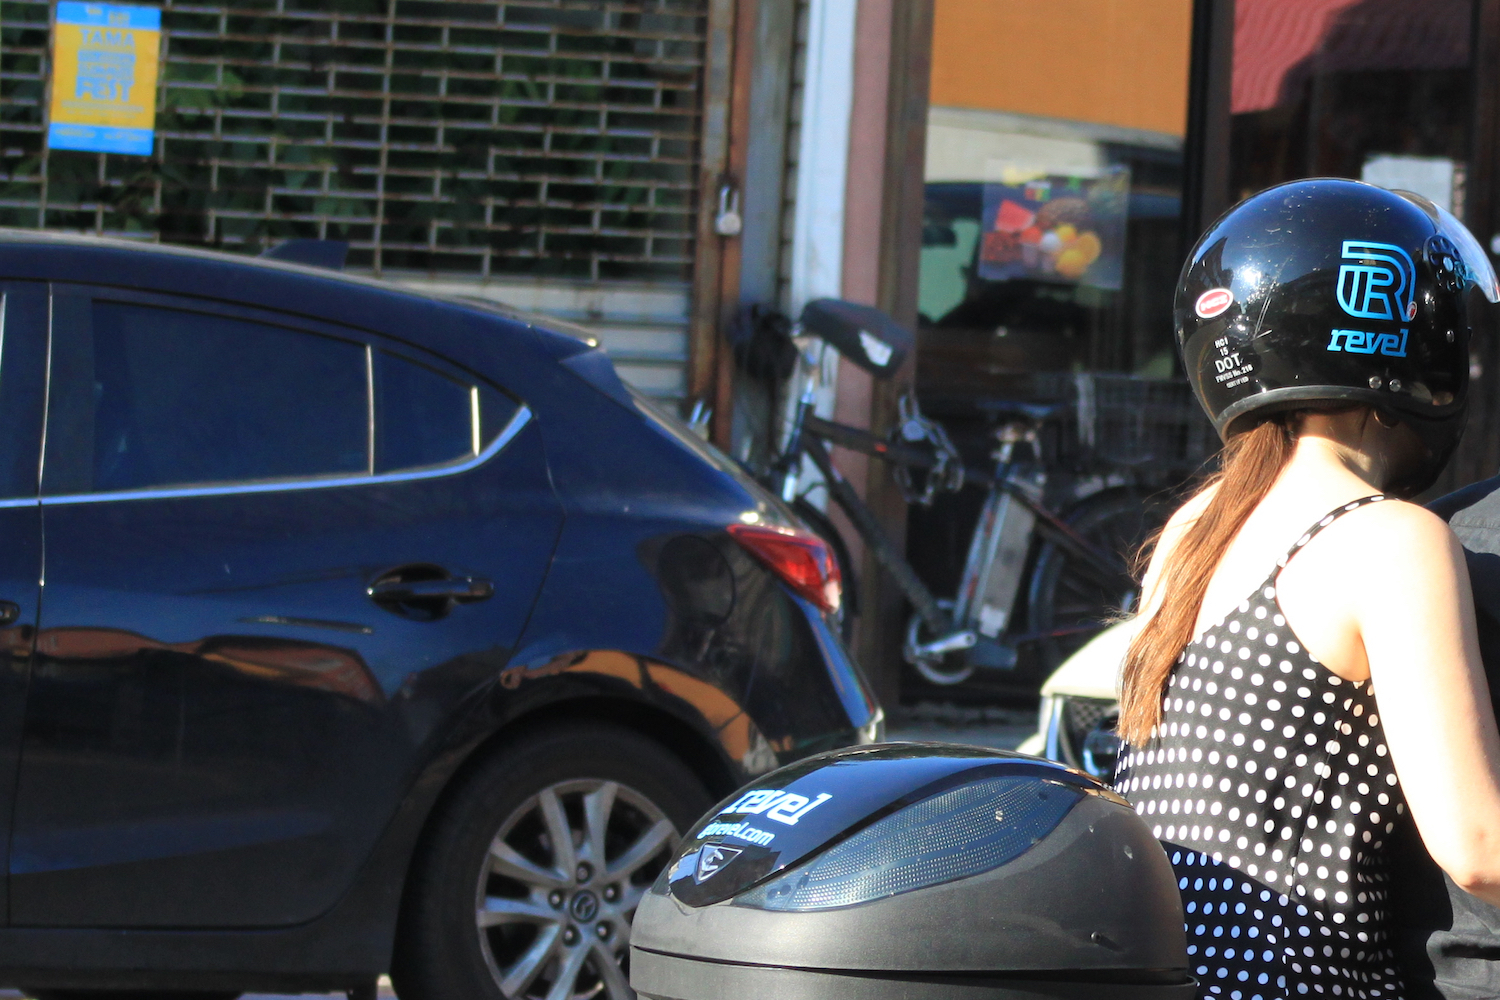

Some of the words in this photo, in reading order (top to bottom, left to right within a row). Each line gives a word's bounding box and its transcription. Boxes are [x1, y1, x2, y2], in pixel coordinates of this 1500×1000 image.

[1327, 328, 1409, 358] revel
[1215, 353, 1240, 373] DOT
[719, 789, 833, 826] revel
